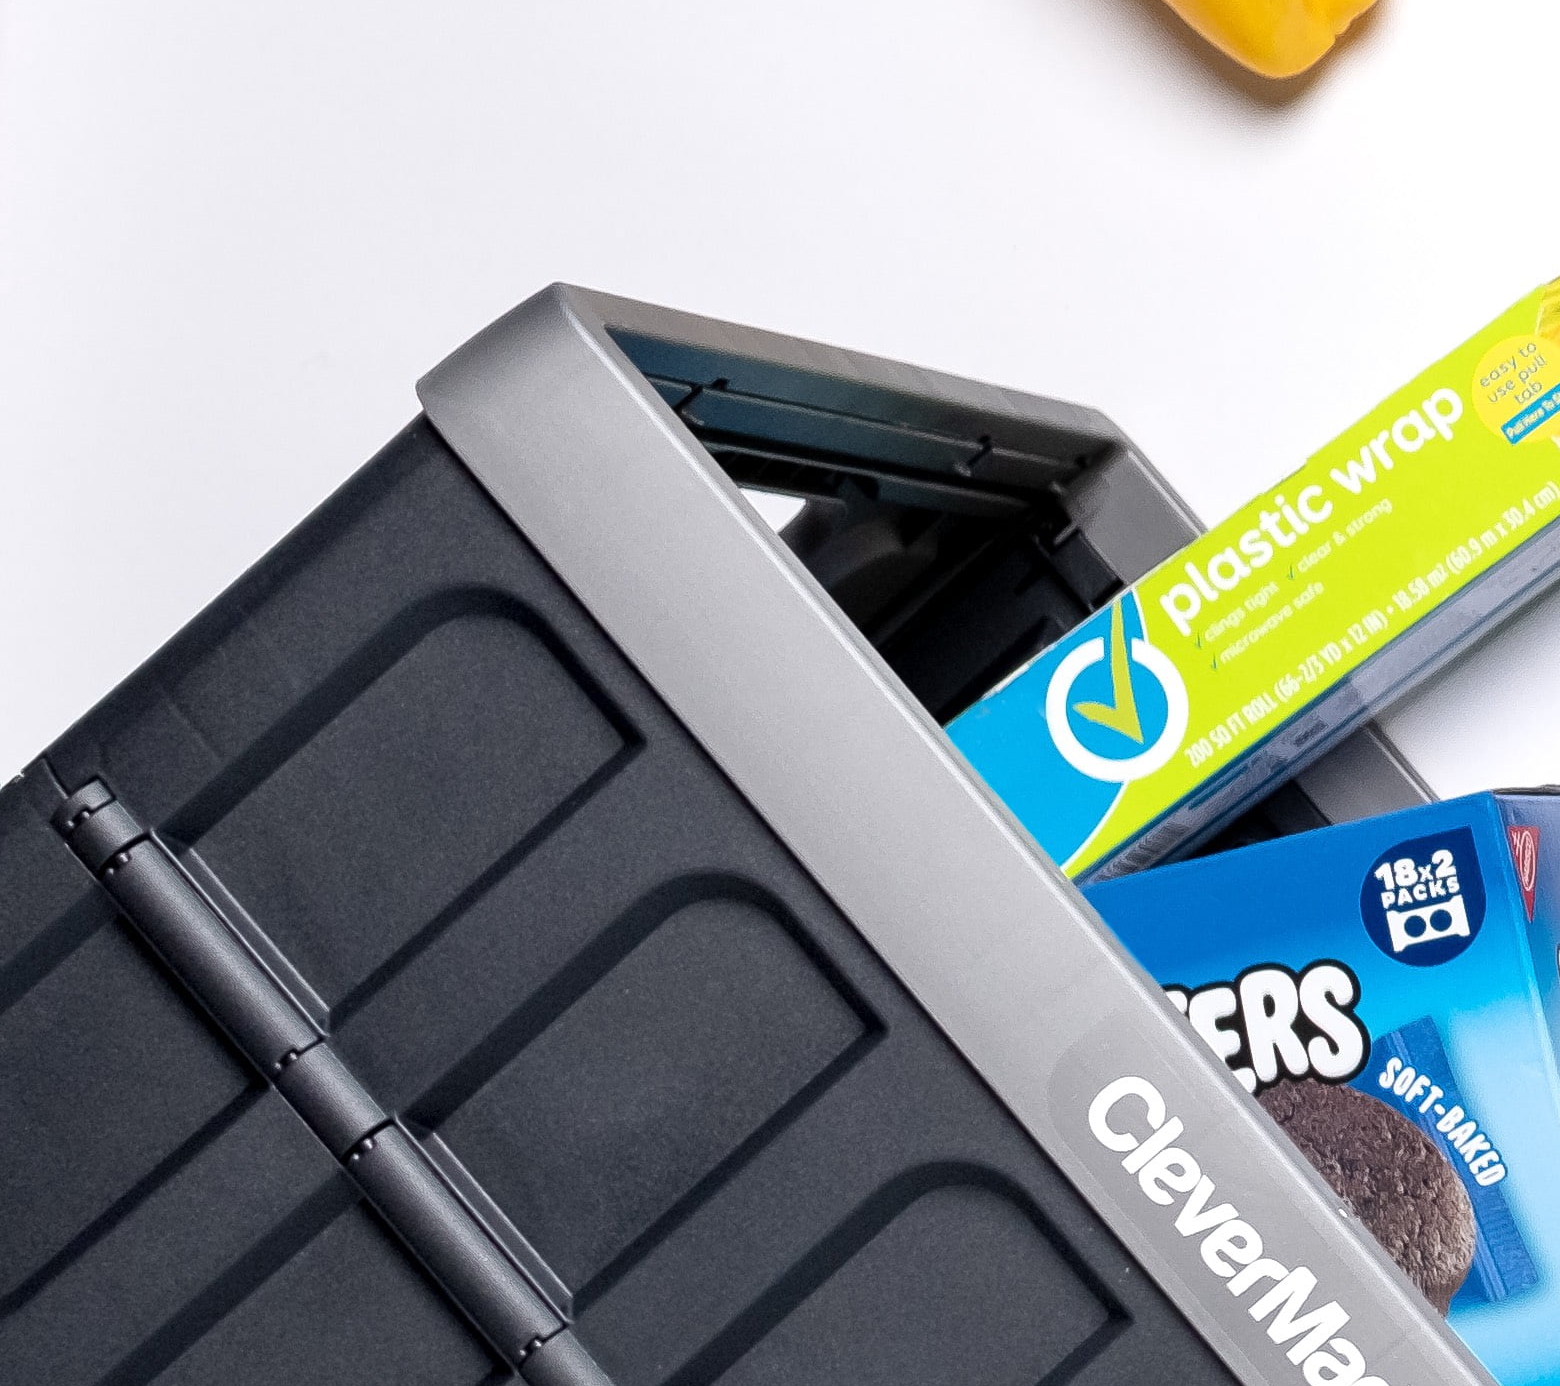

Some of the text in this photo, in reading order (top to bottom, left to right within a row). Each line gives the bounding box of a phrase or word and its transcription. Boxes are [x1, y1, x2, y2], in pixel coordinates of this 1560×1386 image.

[1478, 349, 1520, 390] easy
[1486, 379, 1518, 405] use
[1159, 387, 1464, 638] plastic wrap
[1219, 600, 1292, 666] microwave
[1242, 692, 1277, 727] ROLL
[1374, 848, 1456, 891] 18x2
[1380, 875, 1461, 909] PACKS
[1378, 1057, 1507, 1187] SOFT-BAKED
